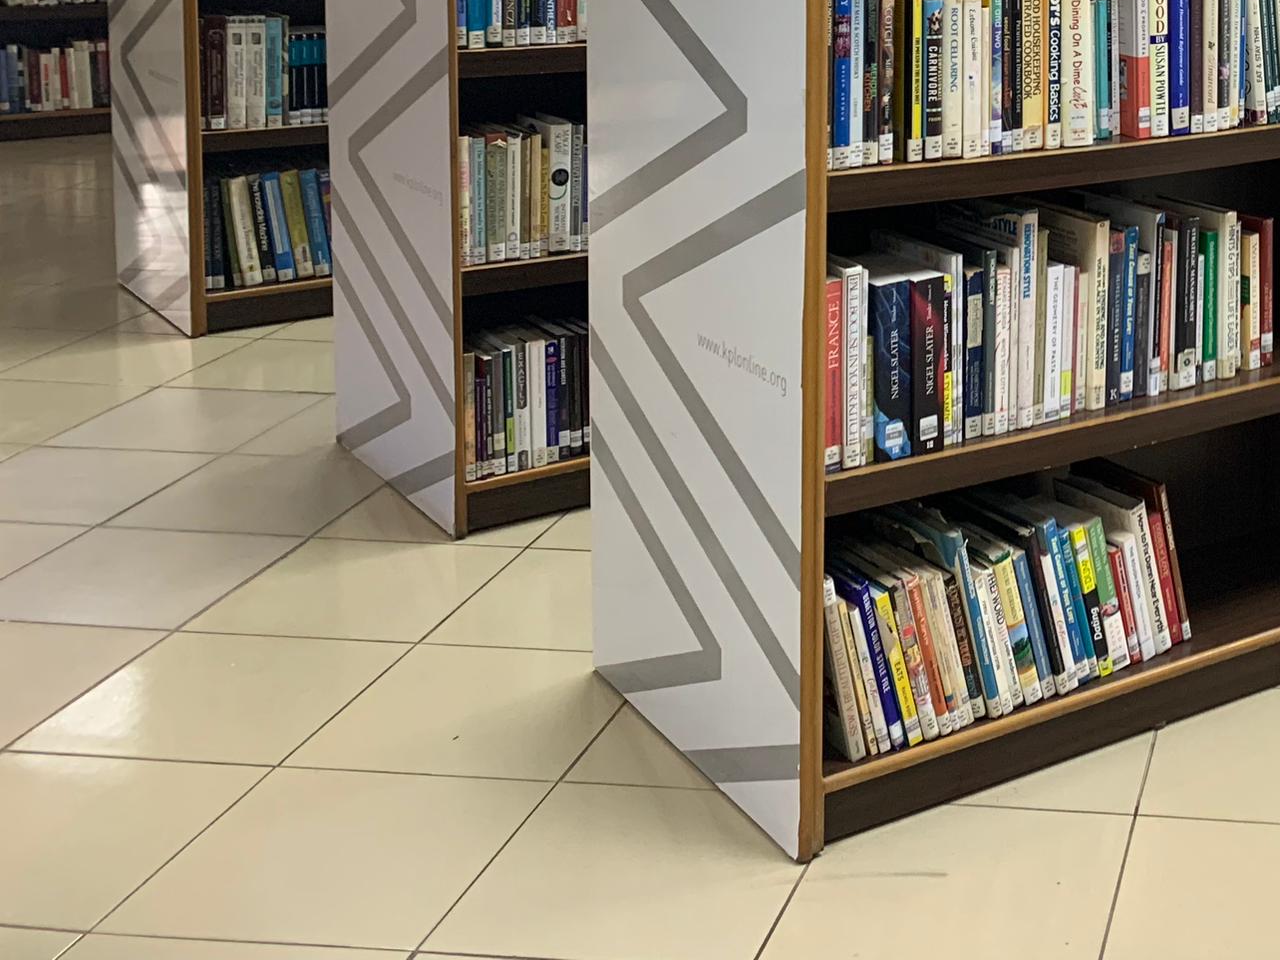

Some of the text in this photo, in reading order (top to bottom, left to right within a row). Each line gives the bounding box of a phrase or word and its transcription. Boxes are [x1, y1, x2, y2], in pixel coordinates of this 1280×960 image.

[1069, 0, 1082, 30] Dining
[949, 7, 959, 93] ROOT CELLARING
[1032, 15, 1041, 96] HOUSEKEEPING
[1048, 29, 1061, 81] Cooking
[1072, 32, 1082, 48] On
[928, 45, 938, 102] CARNIVORE
[1023, 39, 1032, 100] COOKBOOK
[1072, 60, 1083, 85] Dime
[1155, 45, 1166, 78] SUSAN
[1050, 83, 1061, 121] Basics
[1227, 224, 1237, 251] HINTS
[1022, 223, 1032, 299] RENOVATION STYLE
[848, 276, 860, 305] PAUL
[828, 300, 839, 369] FRANCE
[697, 333, 788, 397] www.kplonline.org
[890, 328, 899, 400] NIGEL SLATER
[925, 325, 934, 395] NIGEL SLATER
[1136, 513, 1146, 532] How
[1144, 555, 1155, 579] Damn
[1148, 579, 1159, 599] Near
[1090, 606, 1103, 641] Dating
[861, 593, 891, 693] BENETTON COLOR STYLE FILE
[892, 660, 905, 682] EATS
